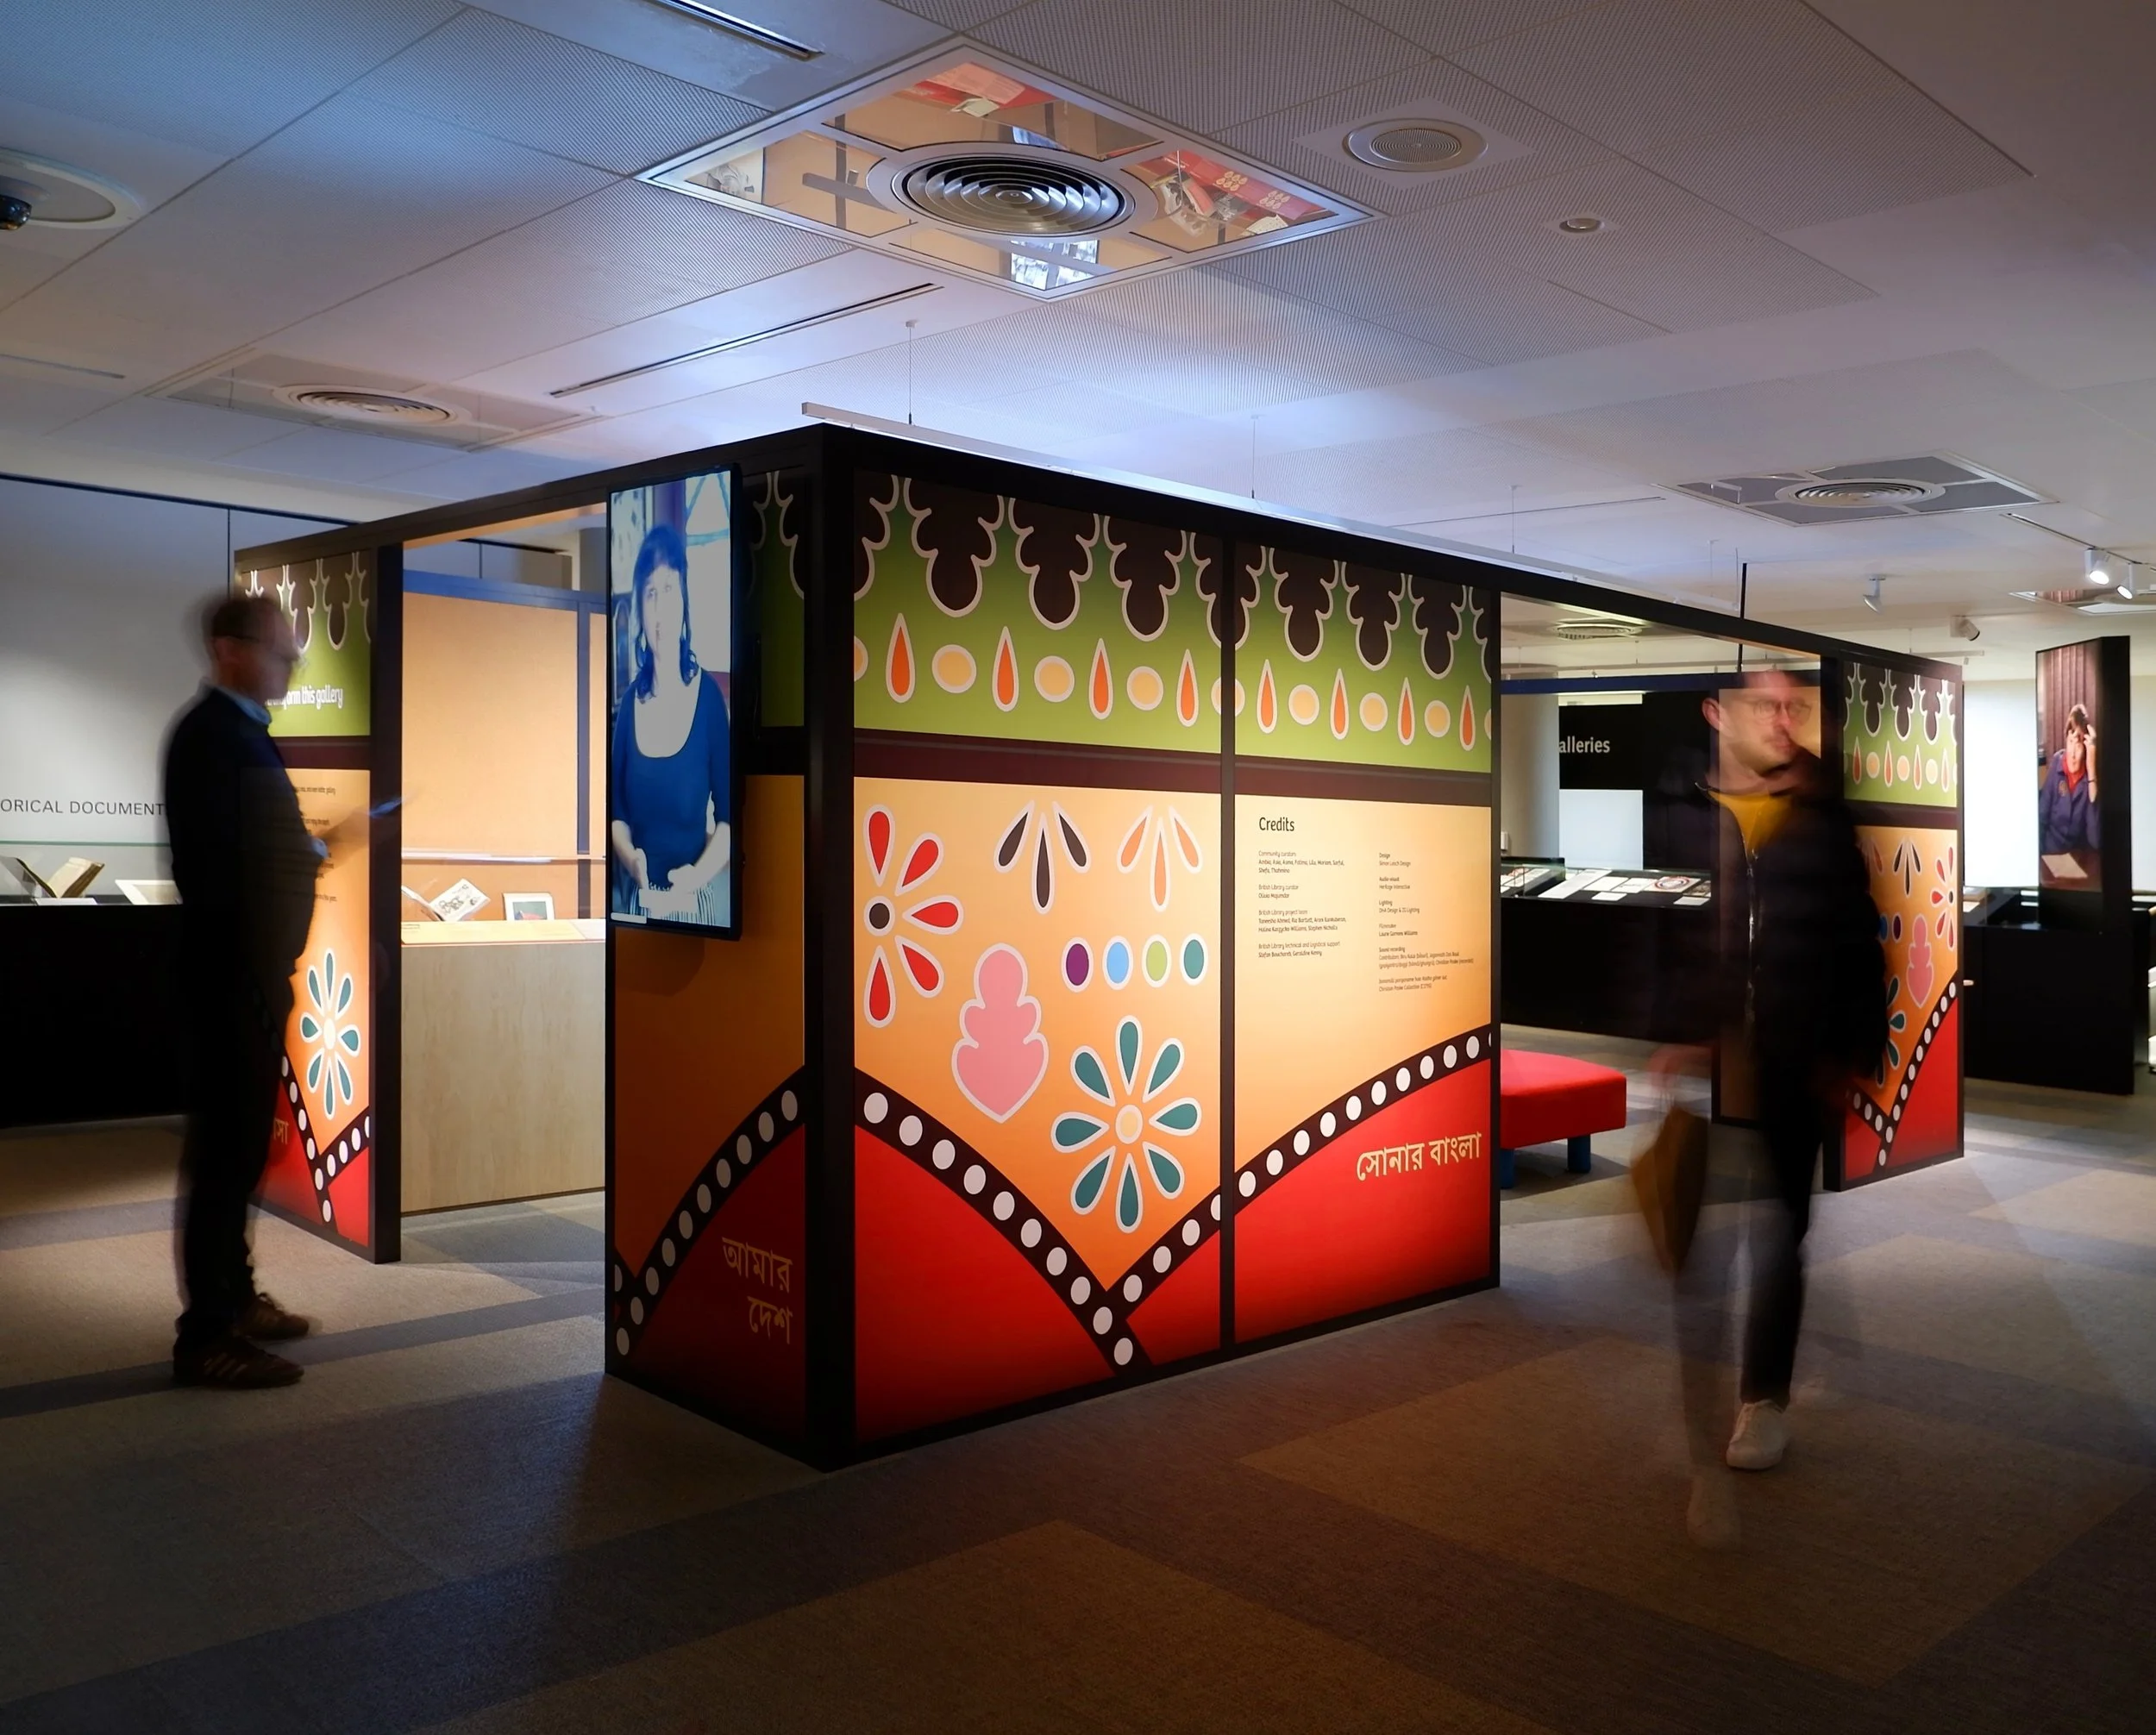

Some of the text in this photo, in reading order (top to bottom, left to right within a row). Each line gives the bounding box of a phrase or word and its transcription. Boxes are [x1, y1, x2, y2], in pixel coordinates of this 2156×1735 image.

[302, 685, 315, 705] this
[316, 684, 343, 710] gallery
[1558, 736, 1610, 753] alleries
[0, 799, 165, 816] ORICAL DOCUMENT
[1258, 817, 1295, 831] Credits
[1357, 1131, 1482, 1181] সোনার বাংলা
[722, 1237, 793, 1293] আমার
[747, 1295, 793, 1344] দেশ
